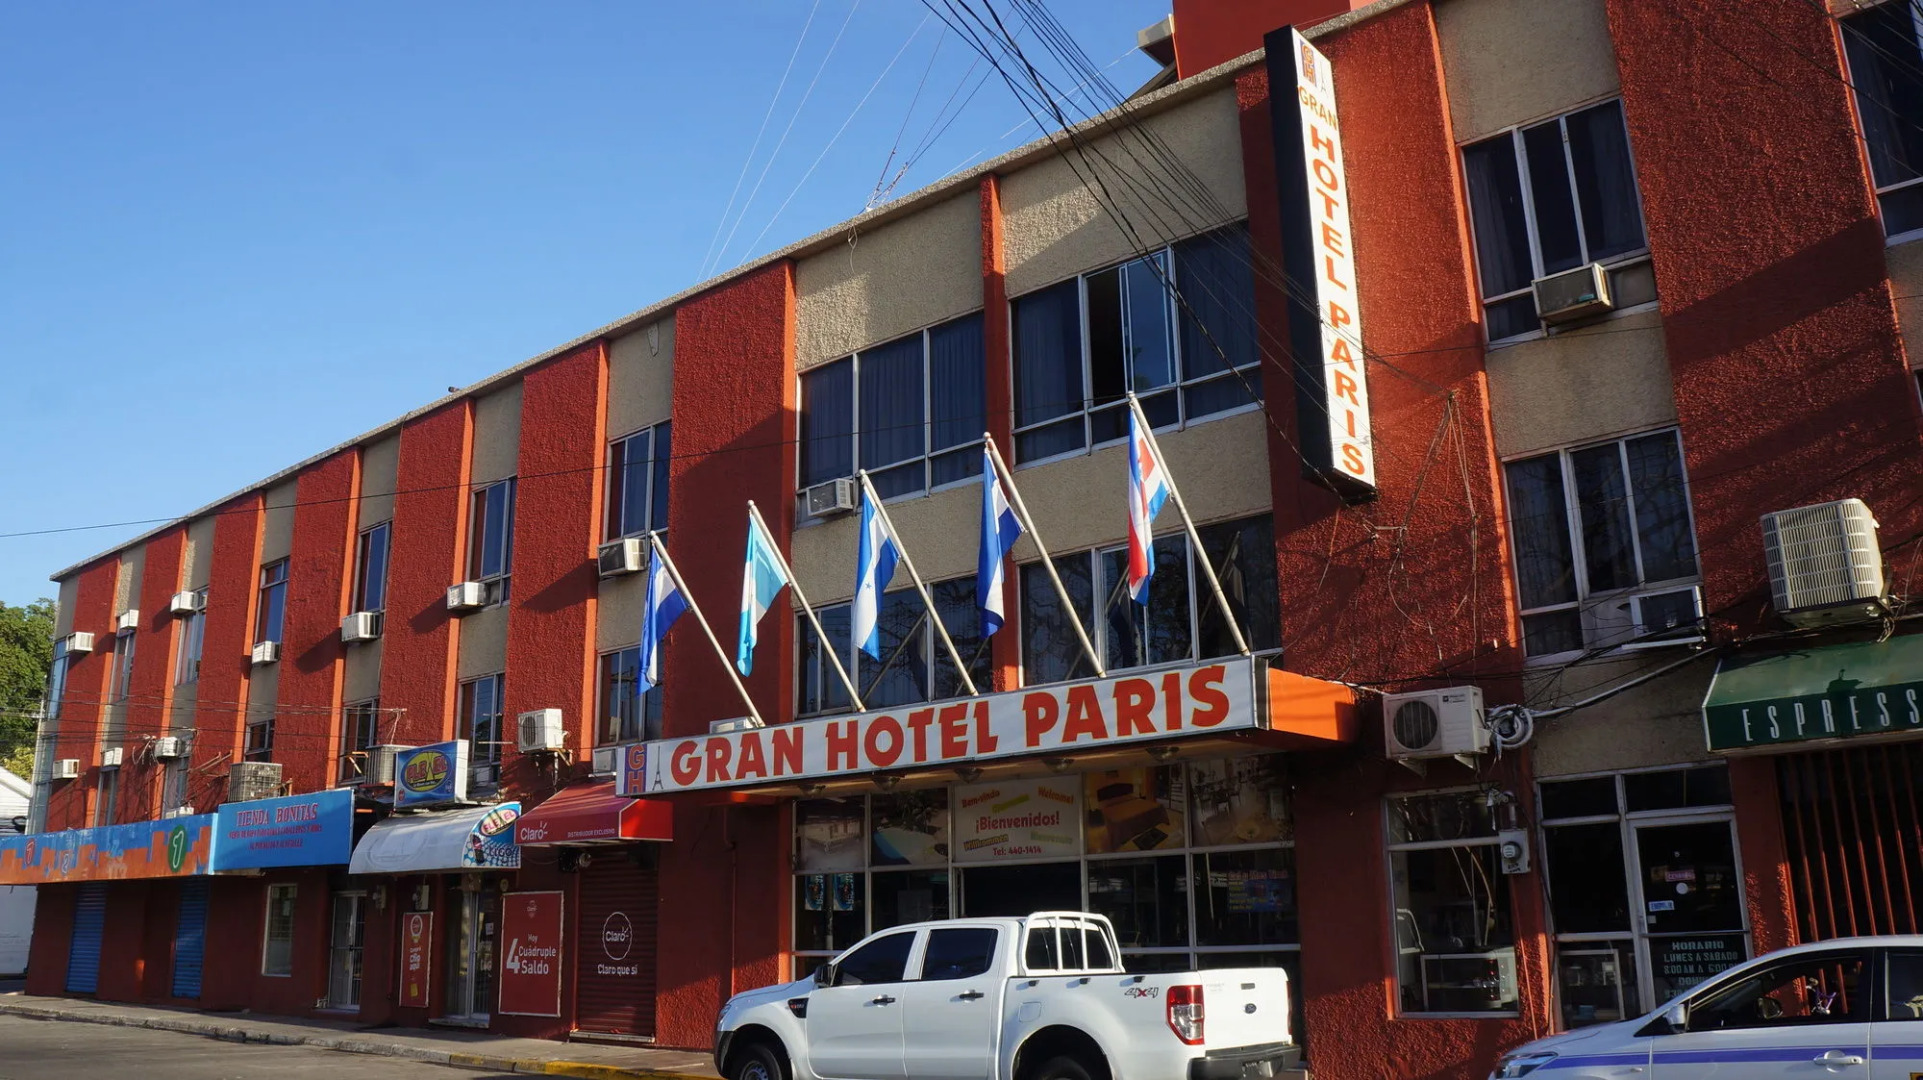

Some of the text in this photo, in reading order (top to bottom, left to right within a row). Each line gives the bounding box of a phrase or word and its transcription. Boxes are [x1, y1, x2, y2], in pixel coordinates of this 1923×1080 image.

[1298, 86, 1337, 131] GRAN
[1310, 124, 1348, 291] HOTEL
[1329, 300, 1366, 477] PARIS
[670, 665, 1230, 786] GRAN HOTEL PARIS
[236, 803, 319, 827] TIENDA BONITAS
[976, 811, 1060, 833] ¡Bienvenidos!
[520, 824, 547, 841] Claro
[528, 934, 539, 944] Hoy
[605, 929, 628, 942] Claro
[518, 945, 557, 958] Cuádruple
[1672, 940, 1725, 951] HORARIO
[506, 938, 520, 974] 4
[1663, 951, 1738, 963] LUNES A SABADO
[521, 960, 549, 974] Saldo
[597, 963, 616, 975] Claro
[617, 966, 631, 976] que
